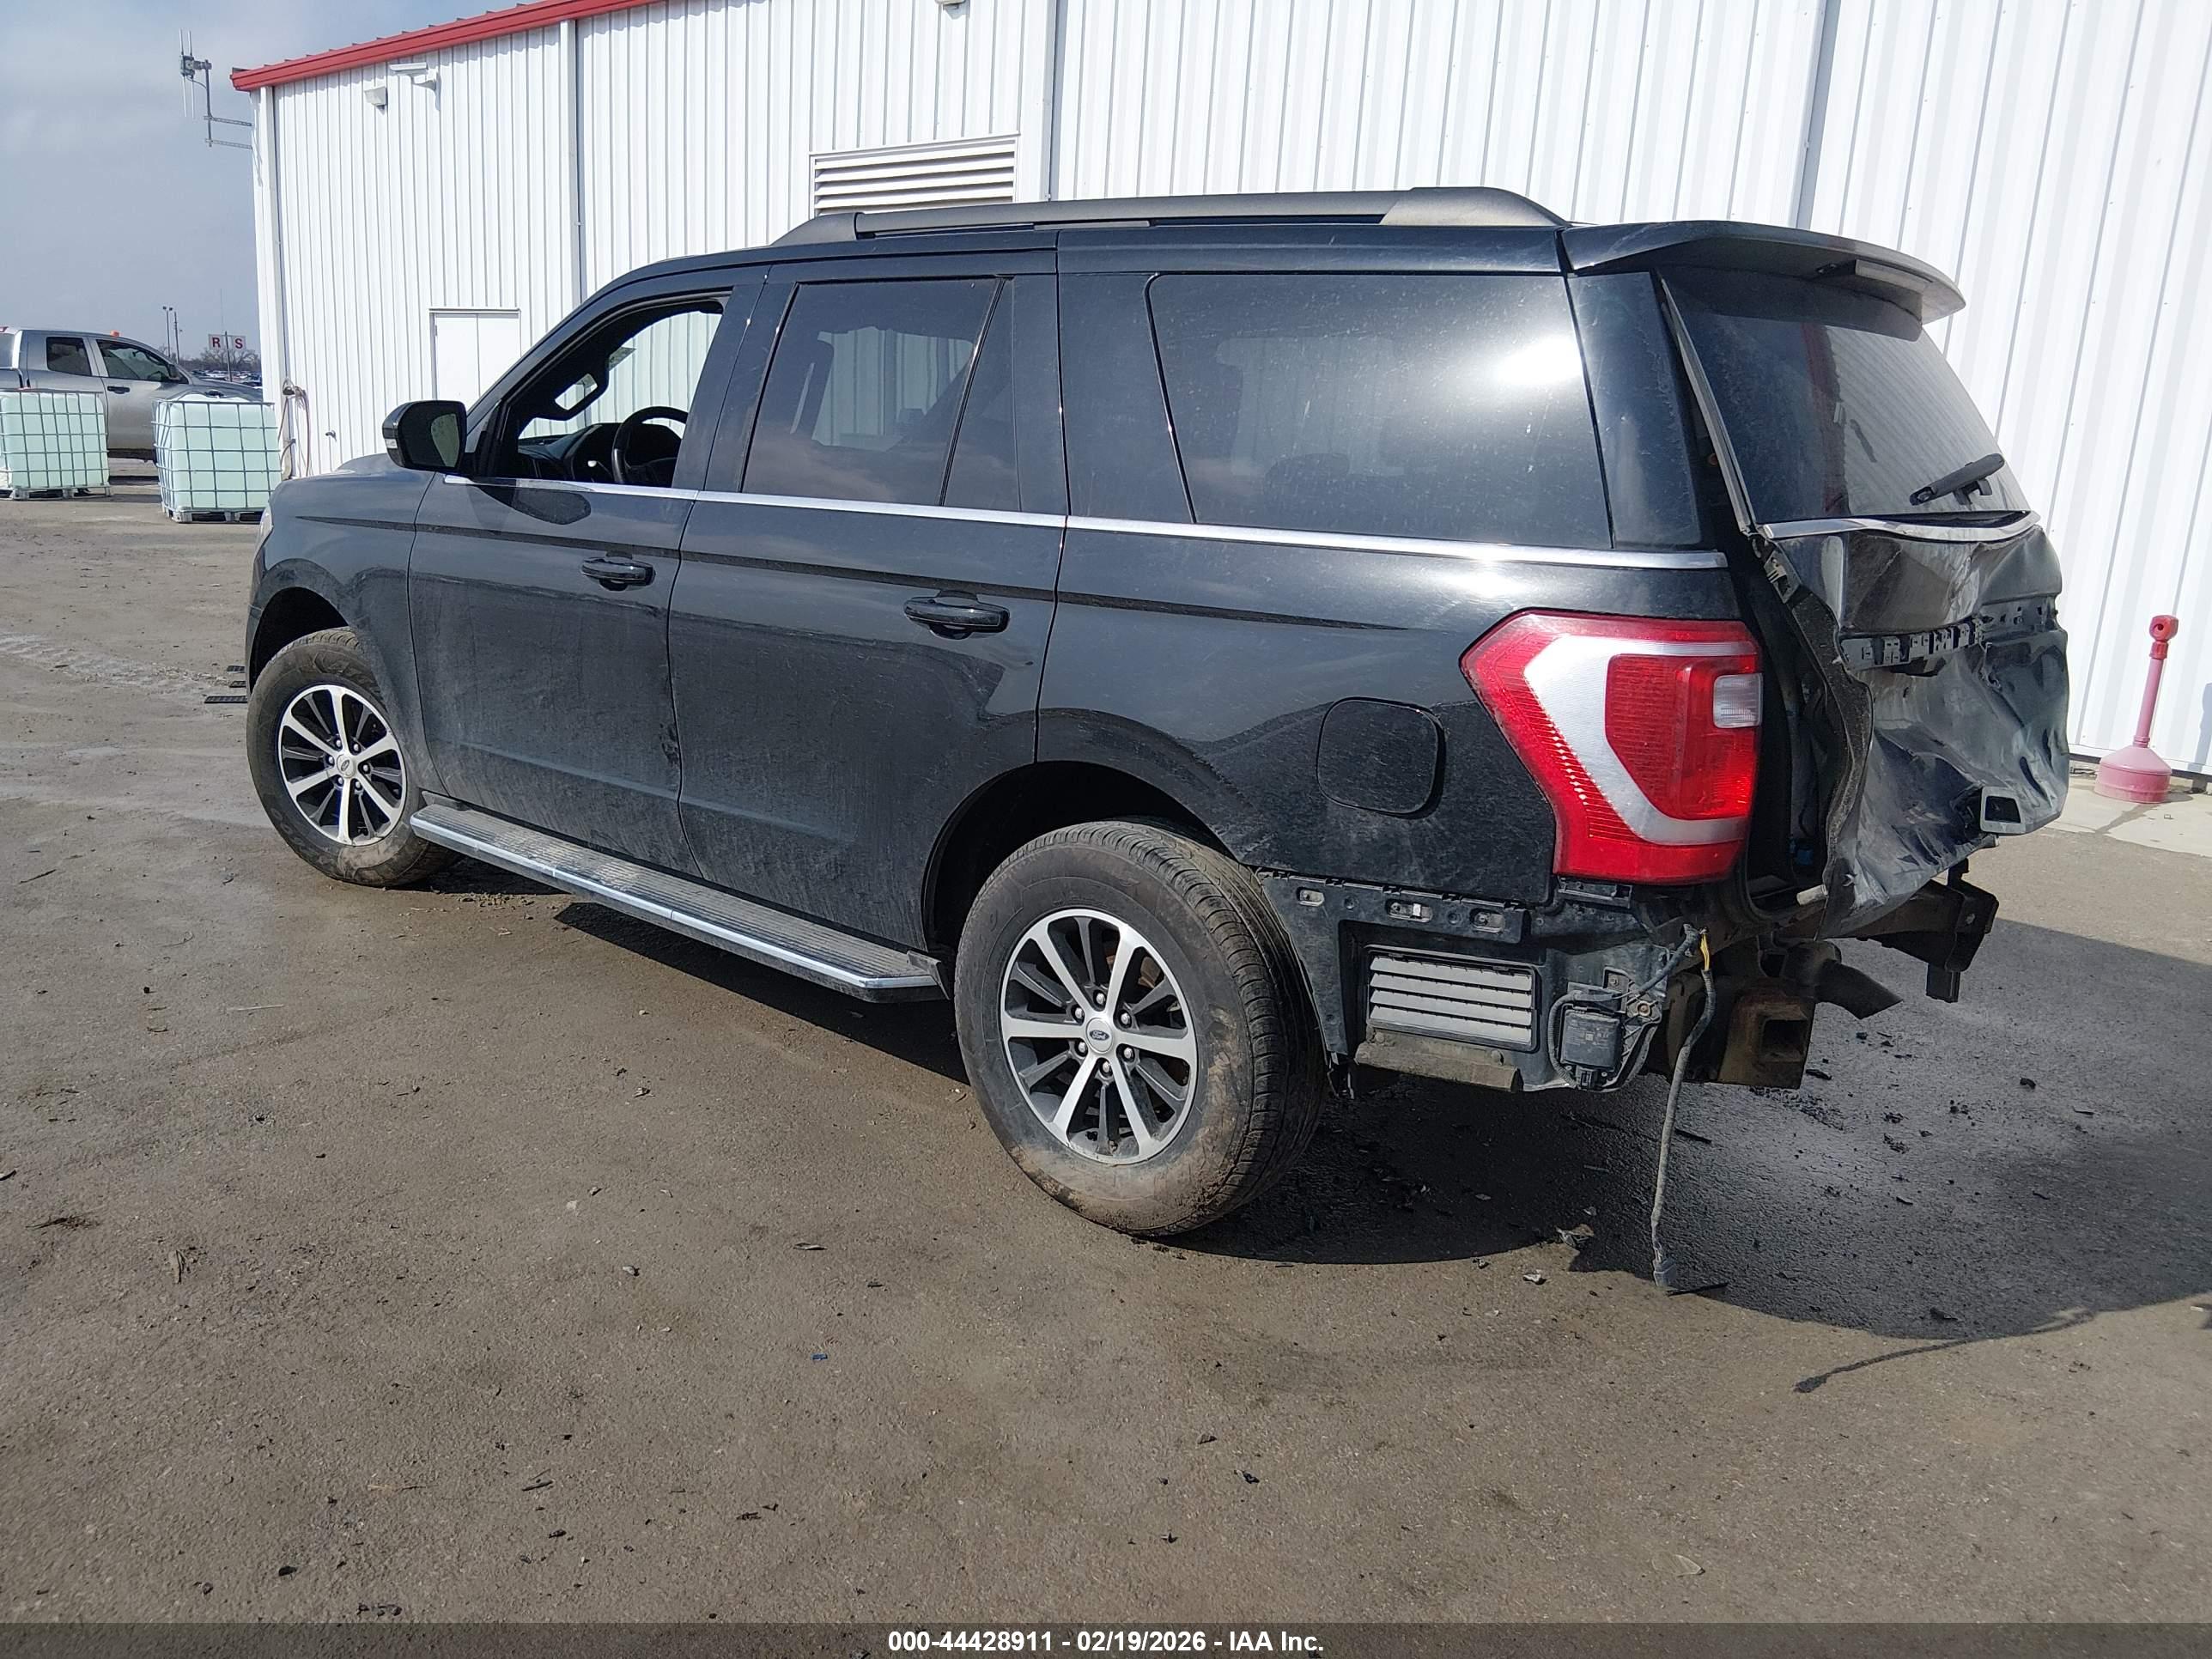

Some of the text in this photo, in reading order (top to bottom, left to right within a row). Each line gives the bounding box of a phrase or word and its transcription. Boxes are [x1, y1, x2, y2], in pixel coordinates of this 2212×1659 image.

[212, 337, 243, 349] R S
[1091, 1030, 1107, 1040] Ford
